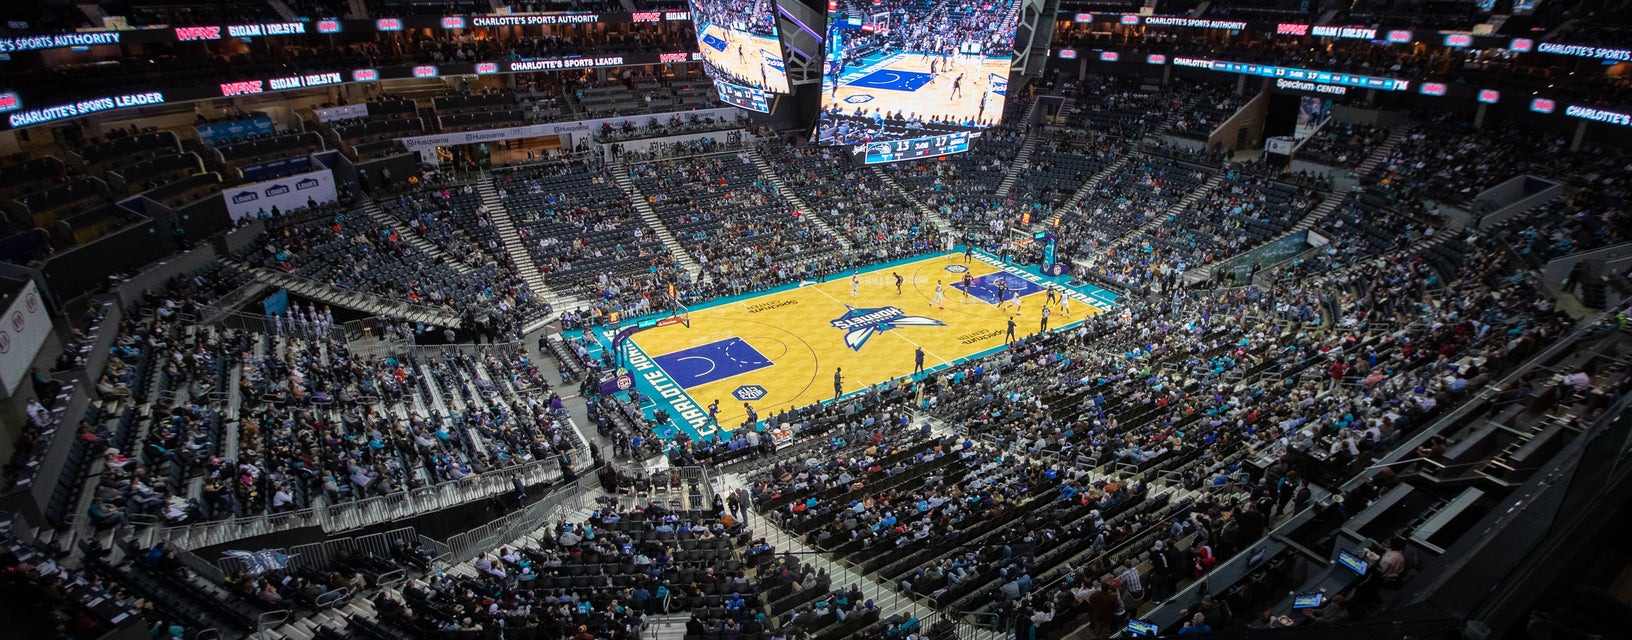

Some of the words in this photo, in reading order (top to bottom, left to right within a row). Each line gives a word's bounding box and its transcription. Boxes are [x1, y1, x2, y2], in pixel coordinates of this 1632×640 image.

[474, 17, 526, 26] CHARLOTTE'S
[528, 16, 556, 25] SPORTS
[558, 14, 598, 24] AUTHORITY
[1145, 17, 1187, 26] CHARLOTTE'S
[1187, 19, 1210, 28] SPORTS
[1210, 20, 1247, 30] AUTHORITY
[15, 36, 54, 50] SPORTS
[54, 32, 120, 47] AUTHORITY
[175, 26, 221, 41] WFNZ
[228, 25, 261, 37] 610AM
[1538, 42, 1595, 57] CHARLOTTE'S
[1594, 48, 1631, 61] SPORTS
[510, 60, 562, 71] CHARLOTTE'S
[564, 58, 594, 68] SPORTS
[595, 57, 623, 67] LEADER
[220, 81, 263, 96] WFNZ
[269, 77, 301, 90] 610AM
[1276, 78, 1315, 91] Spectrum
[1316, 84, 1346, 95] CENTER
[10, 105, 78, 127] CHARLOTTE'S
[77, 97, 115, 113] SPORTS
[115, 92, 165, 107] LEADER
[1565, 105, 1631, 125] CHARLOTTE'S
[415, 137, 449, 146] Husqvarna
[473, 132, 505, 141] Husqvarna
[935, 137, 948, 147] 17
[897, 141, 910, 151] 13
[834, 307, 902, 329] HORNETS
[643, 370, 718, 437] CHARLOTTE
